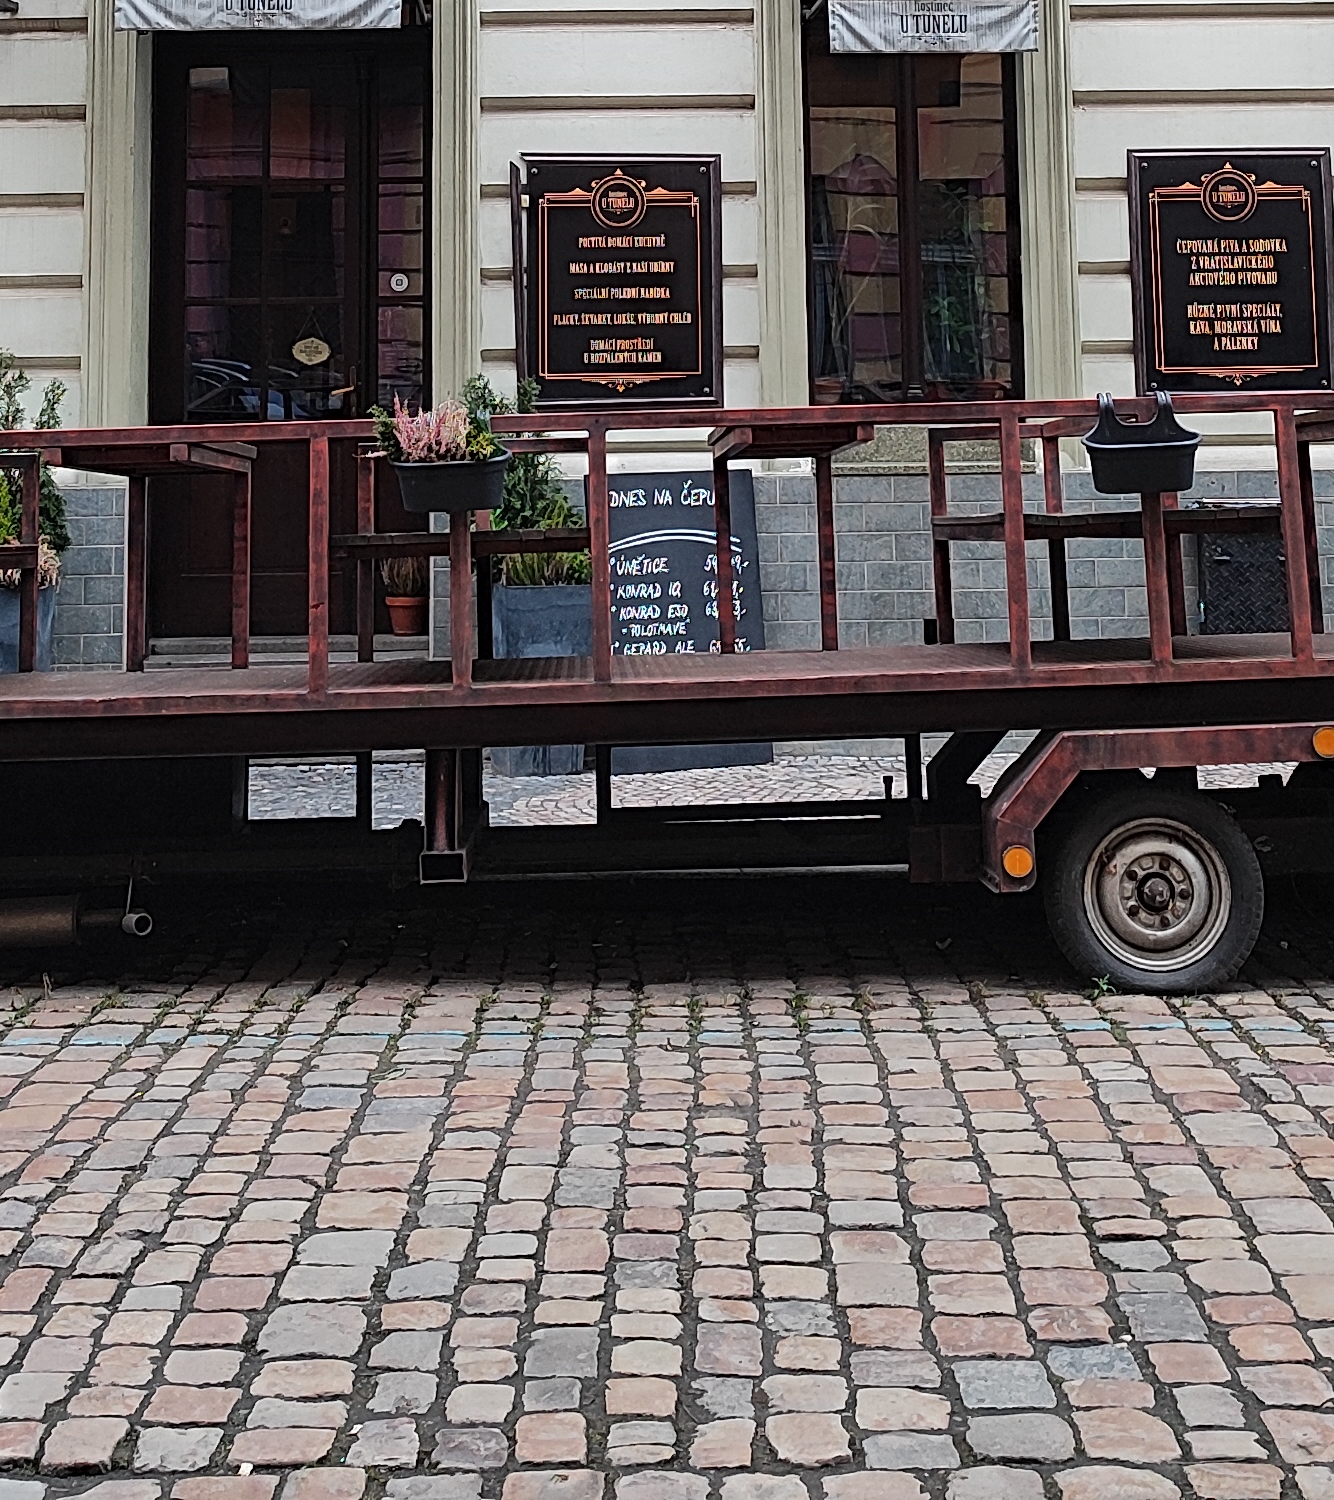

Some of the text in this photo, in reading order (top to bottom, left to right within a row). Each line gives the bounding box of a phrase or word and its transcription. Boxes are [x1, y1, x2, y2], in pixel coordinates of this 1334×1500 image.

[900, 14, 967, 34] U TUNELU
[1176, 238, 1287, 253] ČEPOVANÁ PIVA A SODOVKA
[1217, 303, 1240, 317] PIVNÍ
[1214, 319, 1259, 334] MORAVSKÁ
[1260, 319, 1281, 333] VÍNA
[1214, 336, 1258, 350] A PÁLENKY
[609, 479, 716, 507] DNES NA ČEPU
[617, 583, 662, 599] KONRAD
[619, 605, 661, 621] KONRAD
[674, 640, 696, 654] ALE
